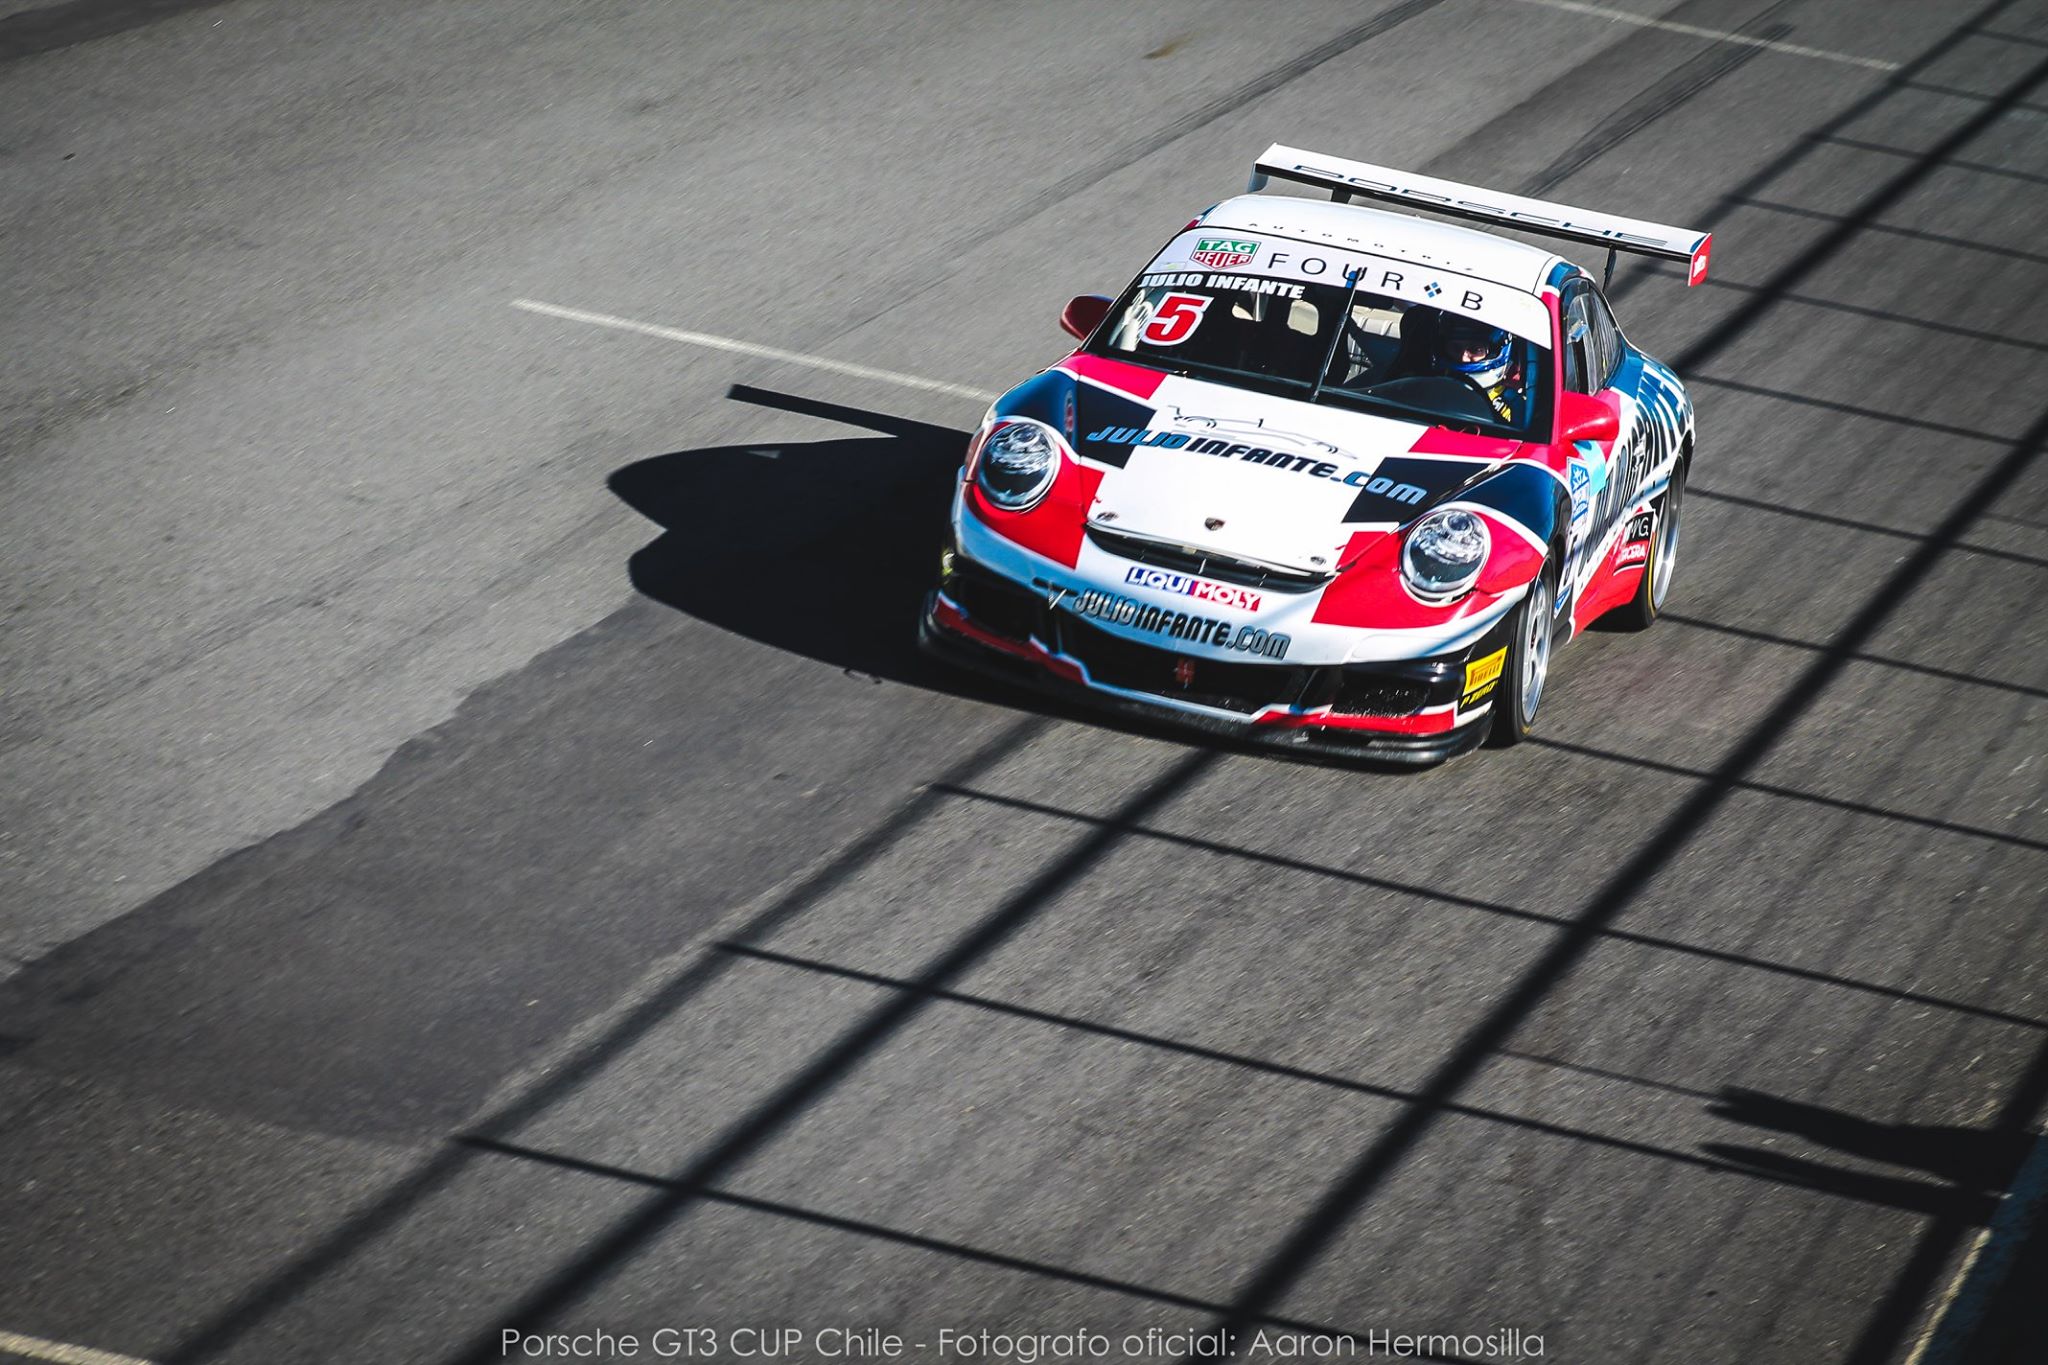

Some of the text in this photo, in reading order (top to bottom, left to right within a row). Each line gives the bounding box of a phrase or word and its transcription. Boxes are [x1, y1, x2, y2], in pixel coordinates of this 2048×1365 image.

[1293, 165, 1668, 247] PORSCHE
[1194, 252, 1250, 269] HEUER
[1203, 240, 1253, 253] TAG
[1138, 274, 1305, 299] JULIO INFANTE
[1267, 252, 1484, 311] FOUR B
[1143, 294, 1210, 344] 5
[1128, 567, 1261, 611] LIQUI MOLY
